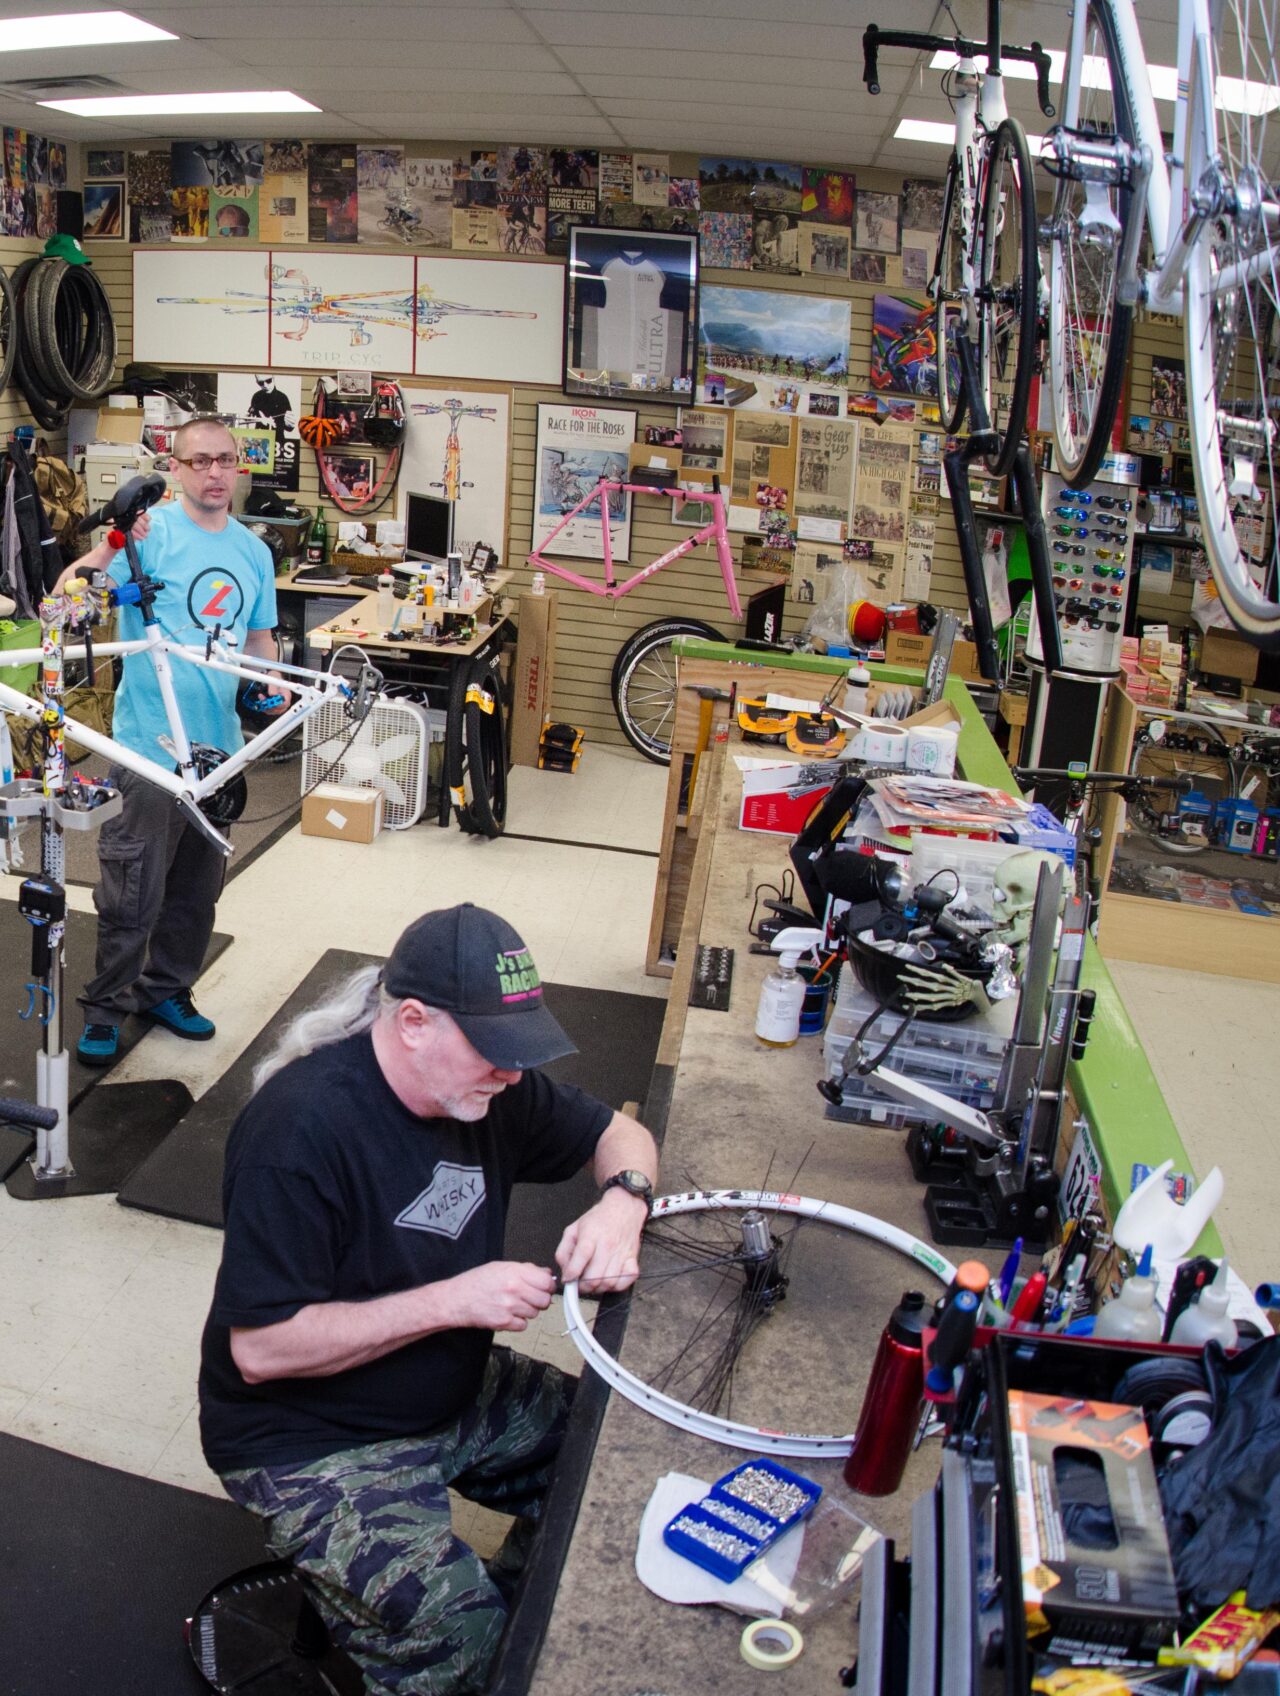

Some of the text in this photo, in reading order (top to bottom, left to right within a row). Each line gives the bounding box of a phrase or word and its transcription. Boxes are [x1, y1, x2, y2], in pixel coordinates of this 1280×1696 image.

[549, 198, 596, 211] MORE TEETH
[649, 314, 664, 374] ULTRA
[572, 408, 596, 418] IKON
[547, 417, 567, 431] RACE
[569, 420, 584, 432] FOR
[587, 421, 600, 433] THE
[602, 422, 625, 436] ROSES
[823, 424, 851, 445] Gear
[831, 443, 849, 462] up
[868, 467, 887, 480] HIGH
[888, 469, 907, 481] GEAR
[642, 543, 687, 577] TREK
[764, 612, 775, 643] LAZER
[528, 656, 539, 712] TREK
[1050, 1006, 1068, 1046] Vittoria
